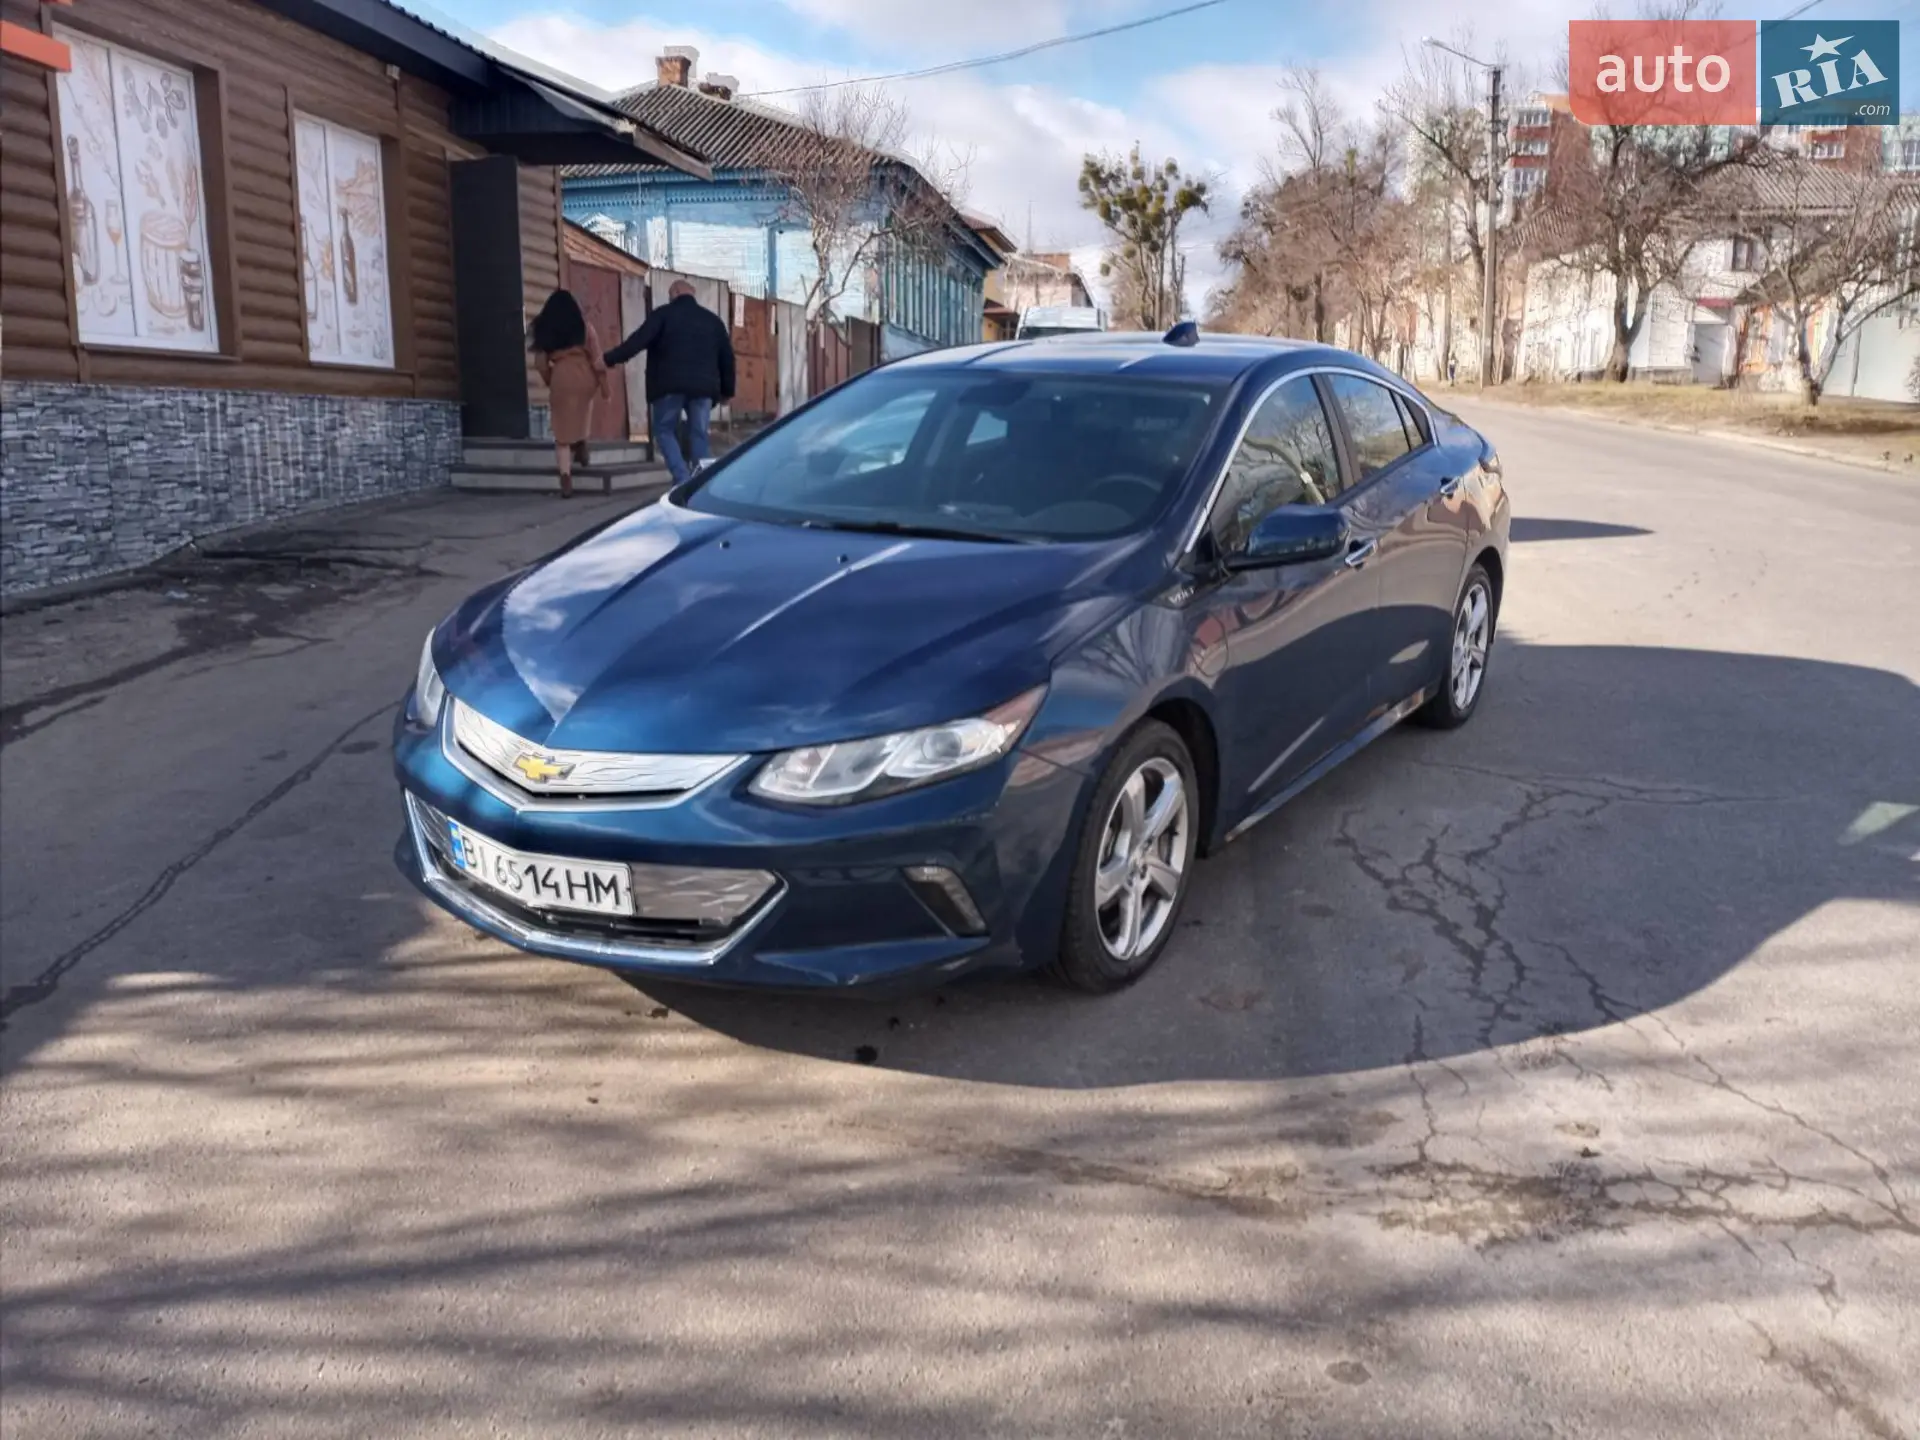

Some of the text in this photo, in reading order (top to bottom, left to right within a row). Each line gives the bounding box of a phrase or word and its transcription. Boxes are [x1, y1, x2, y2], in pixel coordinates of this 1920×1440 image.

[462, 836, 488, 878] BI
[495, 855, 562, 898] 6514
[566, 869, 621, 906] HM
